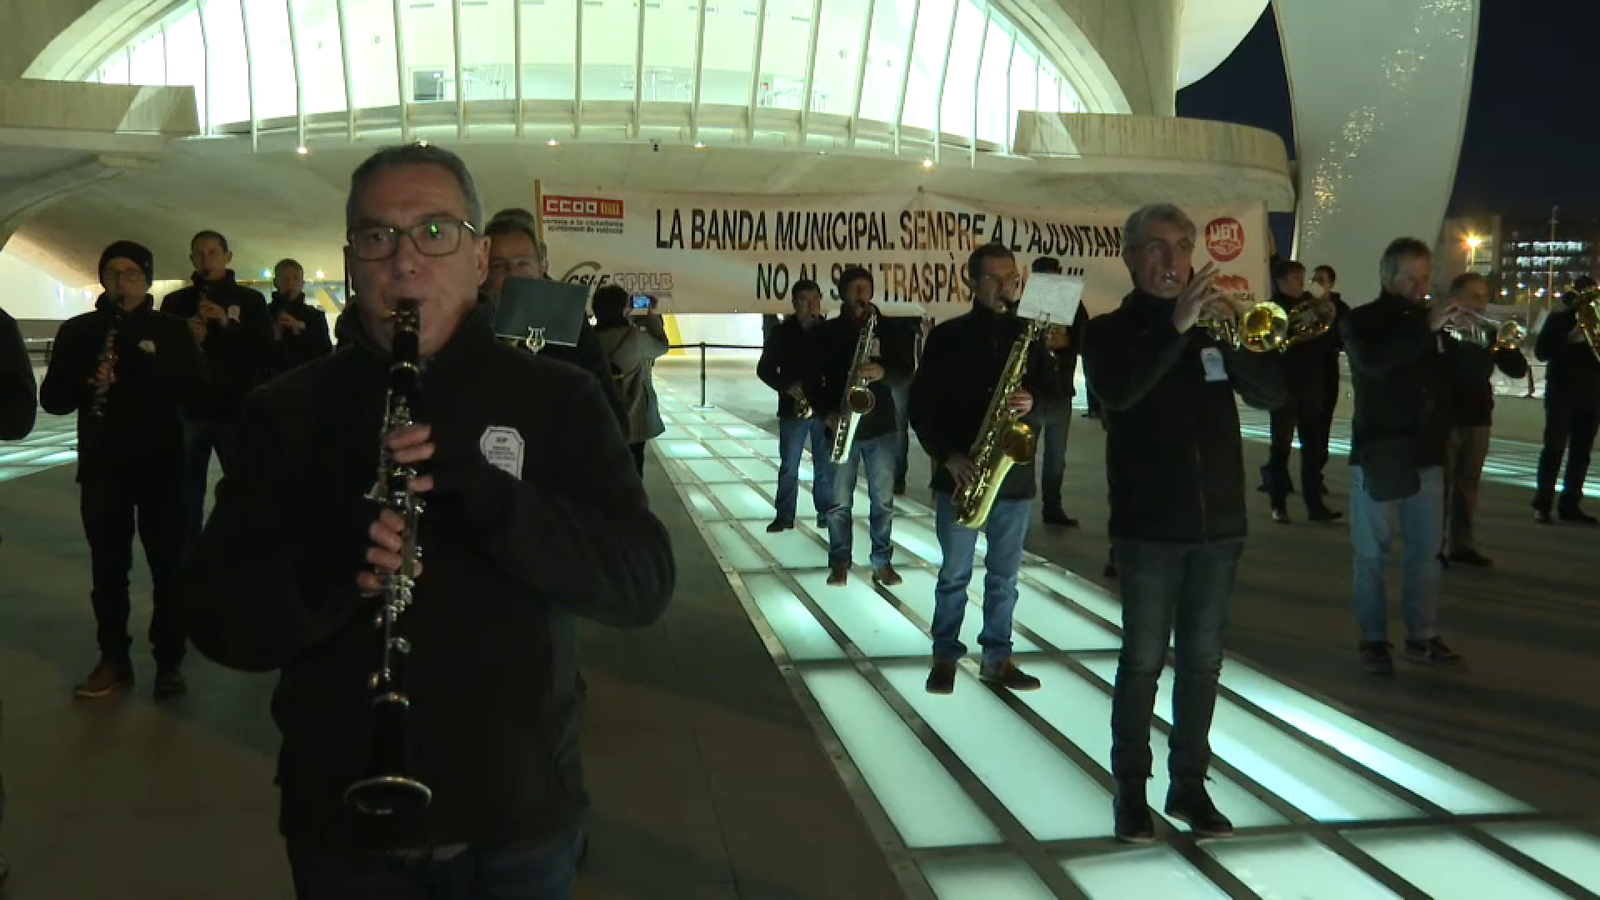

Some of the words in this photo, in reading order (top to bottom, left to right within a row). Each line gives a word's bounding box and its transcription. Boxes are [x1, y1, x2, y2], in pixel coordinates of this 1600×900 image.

[546, 199, 598, 214] CCOO
[656, 209, 684, 249] LA
[691, 209, 768, 251] BANDA
[775, 211, 895, 251] MUNICIPAL
[900, 210, 986, 250] SEMPRE
[989, 215, 1004, 247] A
[1010, 217, 1122, 257] L'AJUNTAM
[756, 263, 789, 300] NO
[880, 253, 974, 302] TRASPÀS
